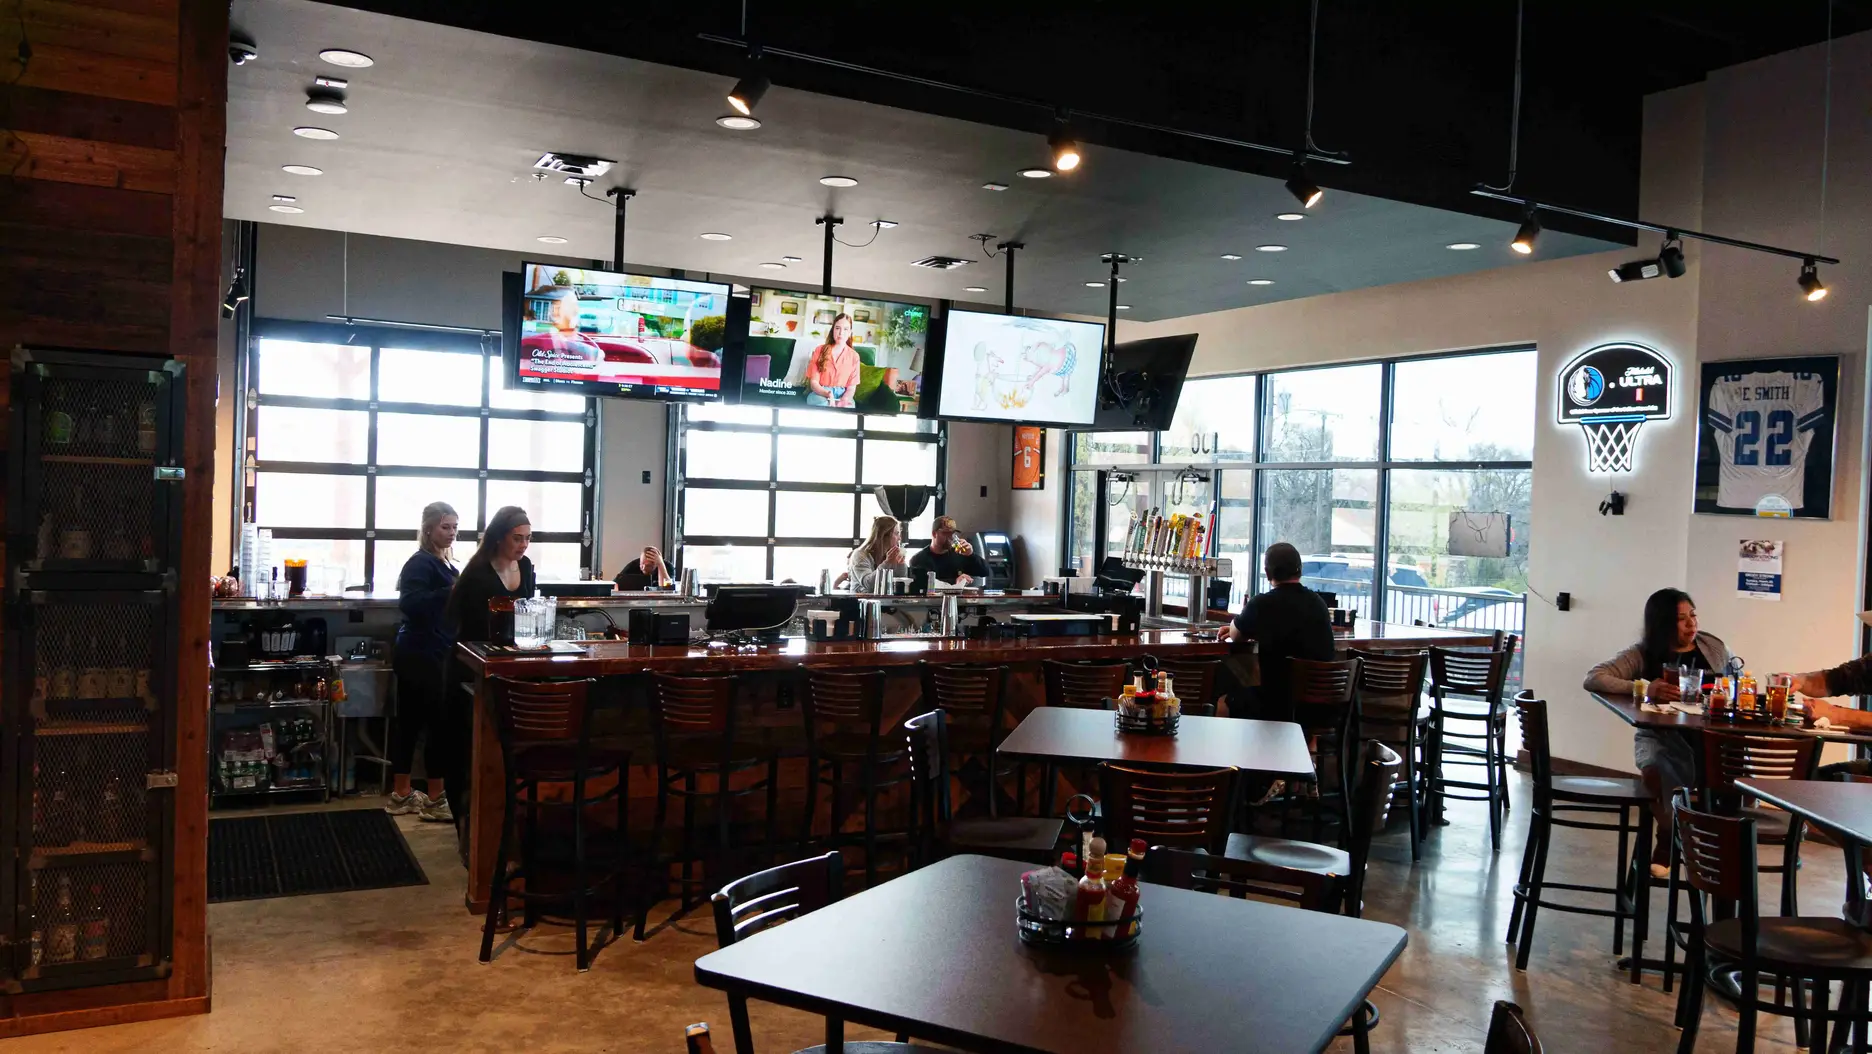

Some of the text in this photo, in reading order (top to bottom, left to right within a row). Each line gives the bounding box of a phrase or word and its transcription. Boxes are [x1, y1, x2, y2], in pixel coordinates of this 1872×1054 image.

[759, 377, 793, 389] Nadine
[1619, 373, 1663, 388] ULTRA
[1755, 386, 1790, 401] SMITH
[1733, 409, 1794, 466] 22
[1024, 446, 1032, 468] 6
